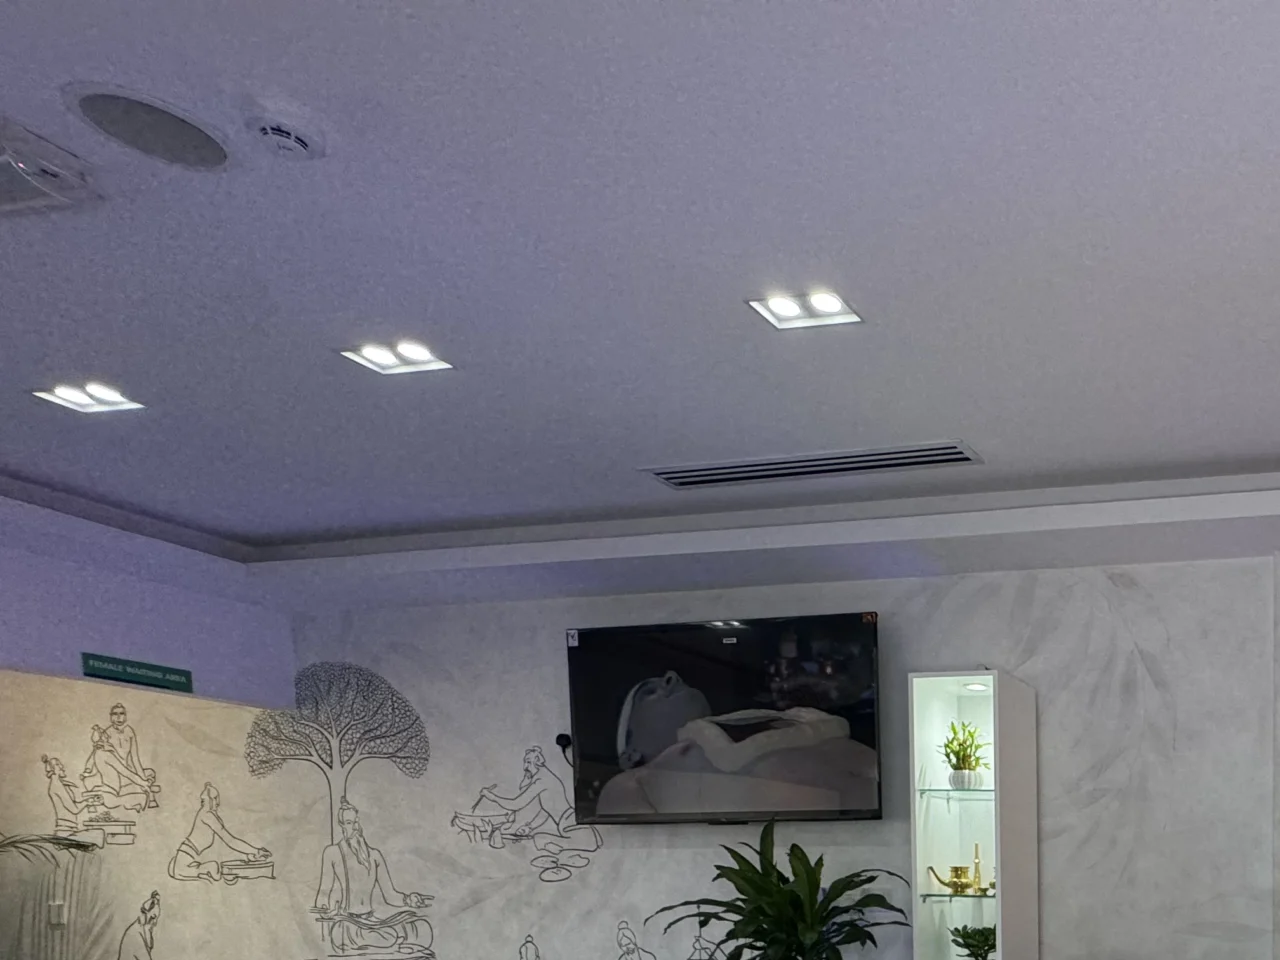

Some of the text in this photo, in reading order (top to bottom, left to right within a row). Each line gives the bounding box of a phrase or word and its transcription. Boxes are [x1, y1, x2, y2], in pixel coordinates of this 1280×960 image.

[88, 659, 187, 683] FEMALE WAITING AREA
